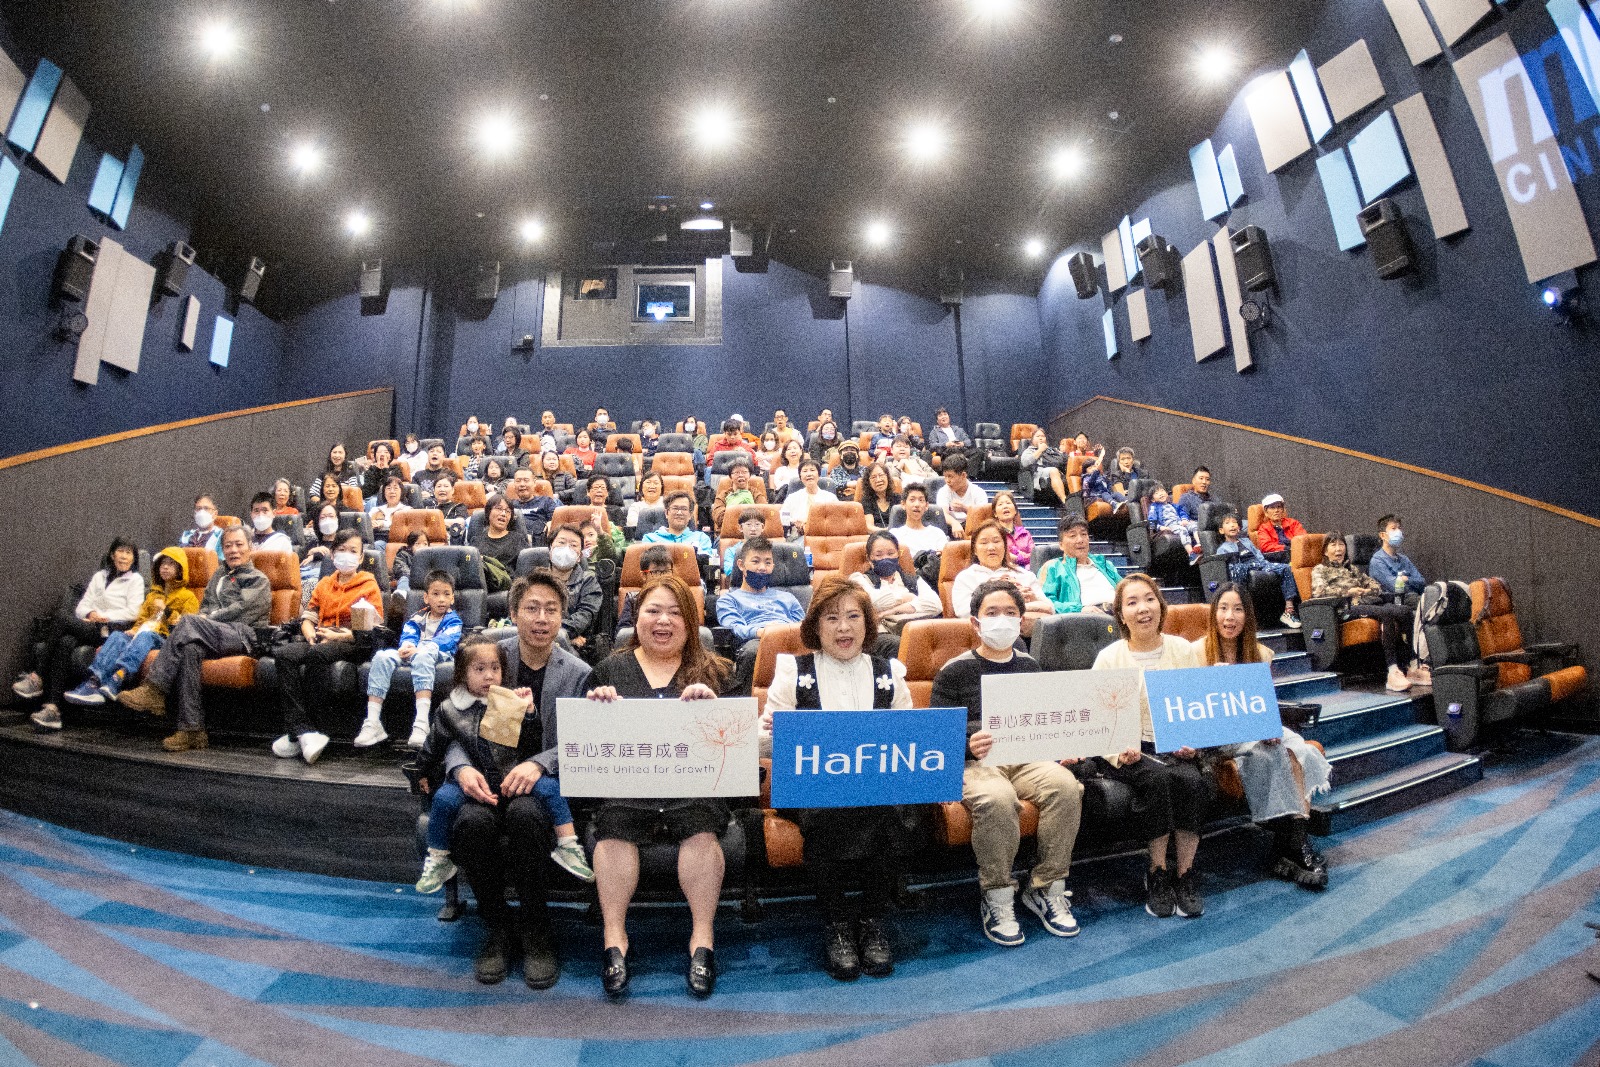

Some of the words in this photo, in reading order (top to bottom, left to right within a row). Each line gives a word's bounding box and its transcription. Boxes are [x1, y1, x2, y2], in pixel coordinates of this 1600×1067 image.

[683, 551, 689, 559] 9
[792, 551, 798, 559] 8
[1107, 625, 1113, 633] 6
[1164, 690, 1267, 723] HaFiNa
[988, 708, 1092, 730] 善心家庭育成會
[991, 734, 1026, 744] amilies
[1029, 730, 1060, 741] United
[1062, 728, 1075, 738] for
[1078, 726, 1110, 737] Growth
[565, 742, 689, 759] 善心家庭育成會
[795, 742, 945, 775] HaFiNa
[563, 763, 609, 774] Families
[613, 763, 650, 774] United
[654, 763, 670, 774] for
[674, 763, 715, 774] Growth
